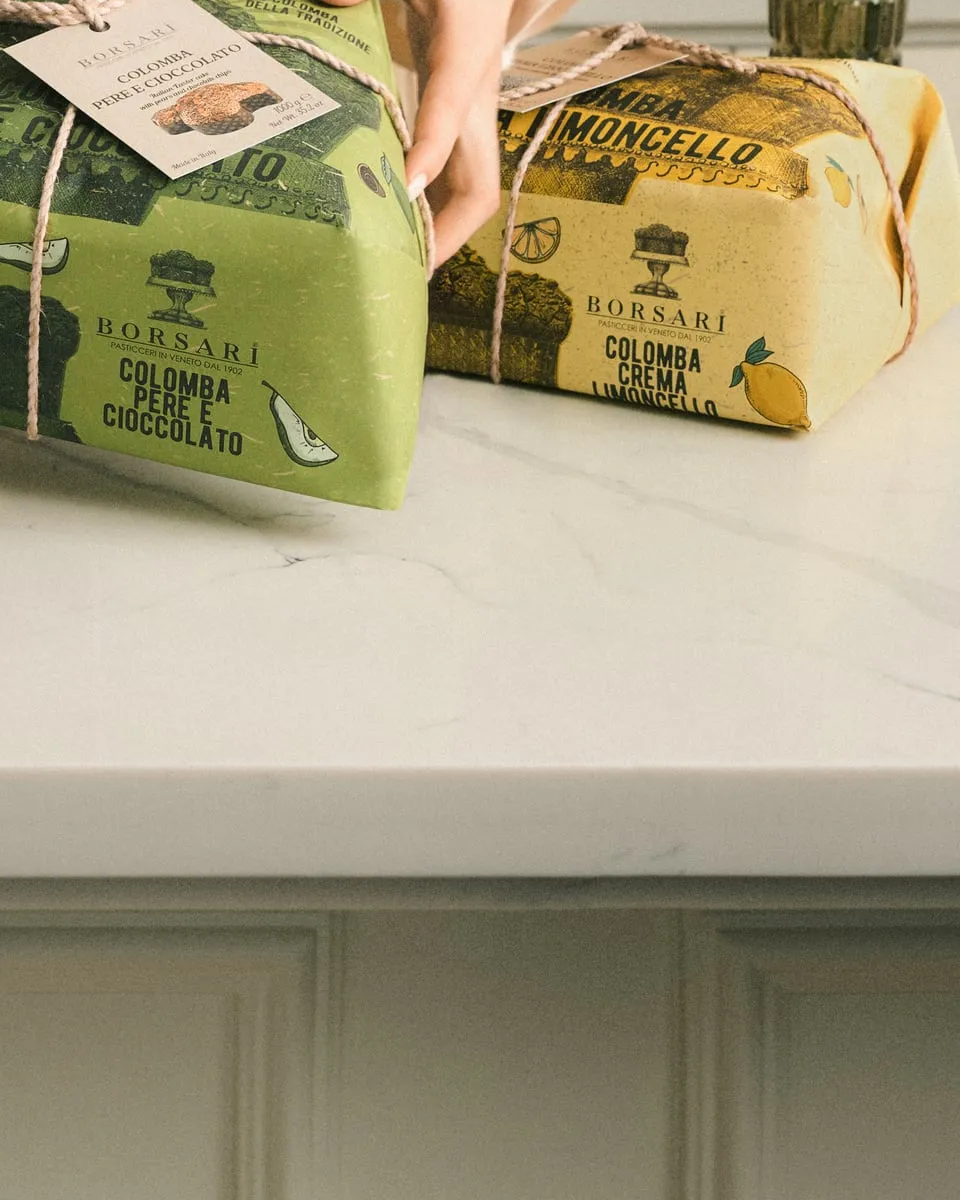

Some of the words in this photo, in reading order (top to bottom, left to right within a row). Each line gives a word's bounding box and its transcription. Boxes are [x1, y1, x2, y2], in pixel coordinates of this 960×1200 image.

[246, 0, 289, 15] DELLA
[297, 11, 372, 55] TRADIZIONE
[92, 88, 134, 110] PERE
[131, 84, 146, 94] E
[144, 43, 242, 88] CIOCCOLATO
[116, 50, 192, 84] COLOMBA
[110, 341, 157, 359] PASTICCERI
[158, 350, 168, 360] IN
[168, 353, 202, 368] VENETO
[203, 359, 222, 371] DAL
[223, 364, 243, 376] 1902
[606, 335, 701, 374] COLOMBA
[119, 357, 230, 405] COLOMBA
[618, 362, 688, 396] CREMA
[133, 385, 191, 421] PERE
[199, 400, 214, 426] E
[103, 403, 243, 457] CIOCCOLATO
